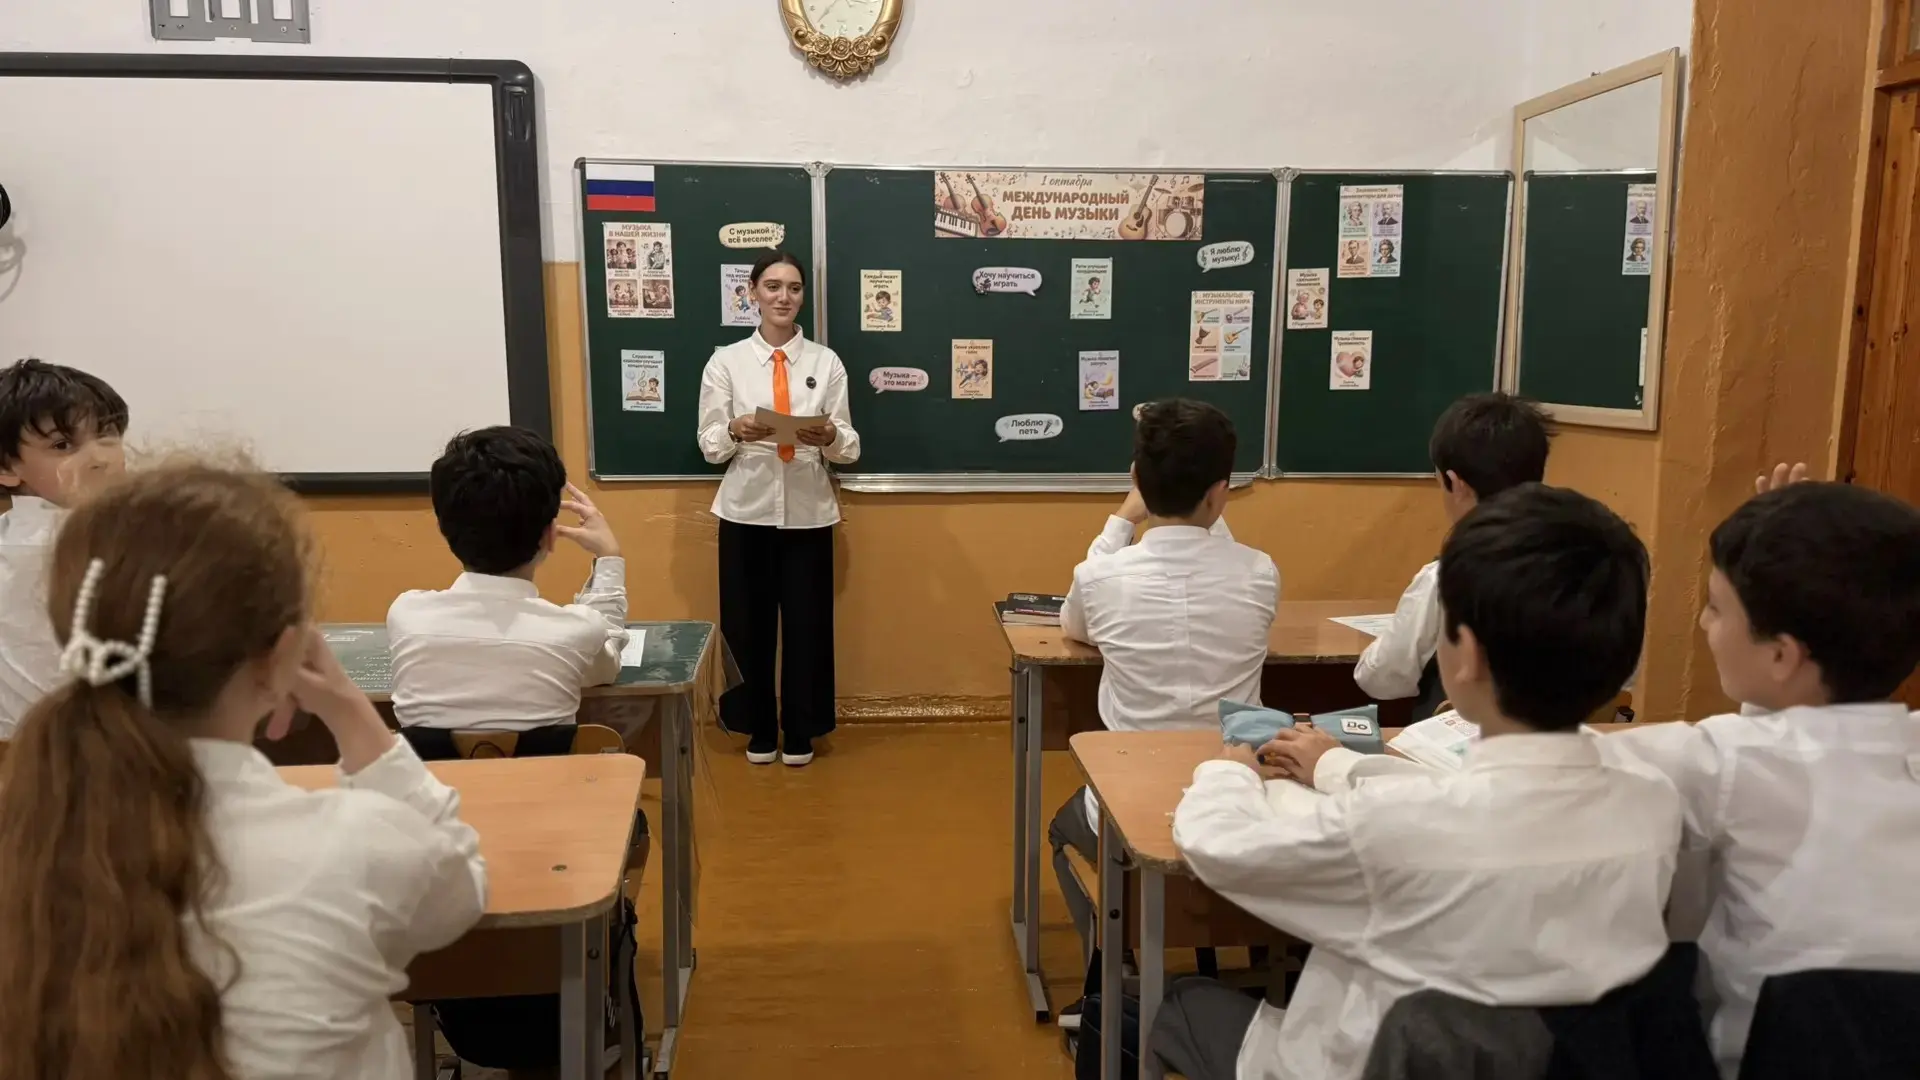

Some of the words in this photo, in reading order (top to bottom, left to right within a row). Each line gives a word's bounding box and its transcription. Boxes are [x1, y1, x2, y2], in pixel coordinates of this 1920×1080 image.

[1041, 174, 1047, 186] 1
[1002, 190, 1130, 206] МЕЖДУНАРОДНЫЙ
[1011, 206, 1051, 221] ДЕНЬ
[1054, 206, 1119, 221] МУЗЫКИ
[736, 227, 770, 237] музыкой
[1216, 246, 1241, 254] люблю
[1212, 253, 1240, 264] музыку!
[980, 271, 997, 280] Хочу
[998, 272, 1035, 281] научиться
[993, 280, 1018, 288] играть
[883, 371, 911, 380] Музыка
[884, 379, 896, 387] это
[896, 379, 917, 387] магия
[1010, 419, 1044, 428] Люблю
[1018, 427, 1039, 436] петь
